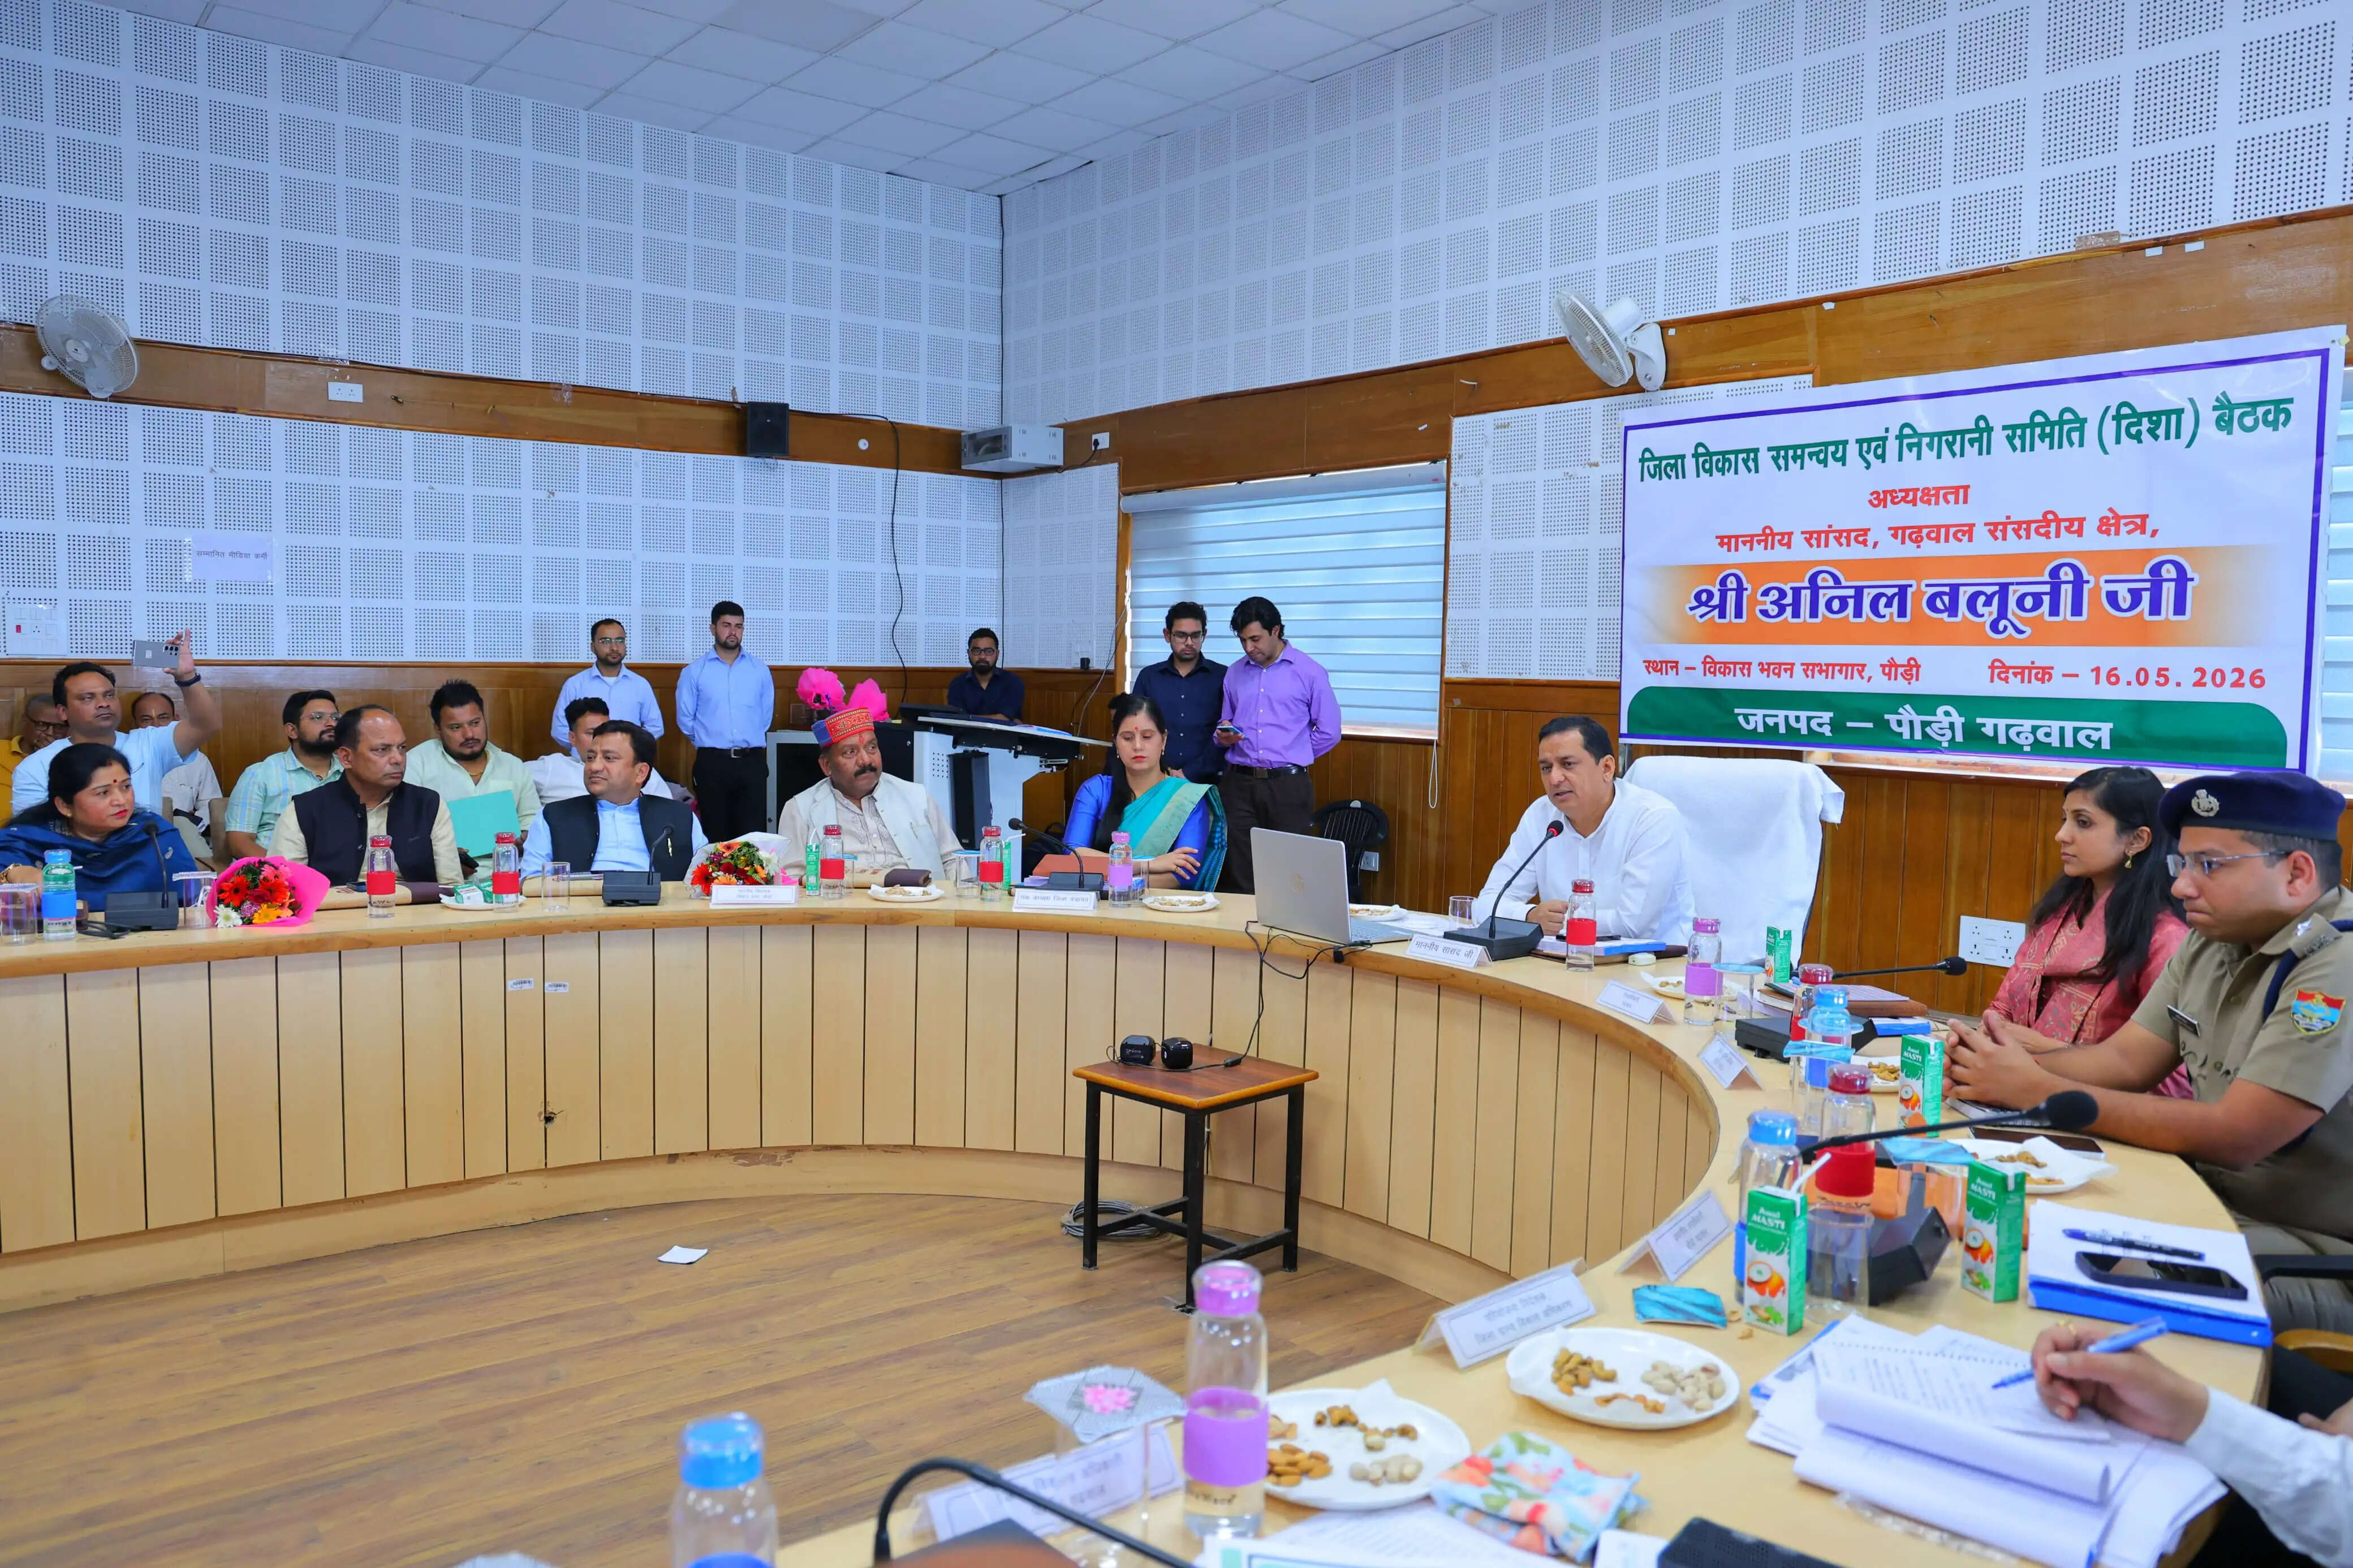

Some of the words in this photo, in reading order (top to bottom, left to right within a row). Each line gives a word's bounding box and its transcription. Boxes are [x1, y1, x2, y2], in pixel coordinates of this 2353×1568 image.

[1639, 447, 1686, 482] जिला
[1692, 442, 1760, 478] विकास
[1767, 439, 1848, 471] समन्वय
[1855, 427, 1889, 470] एवं
[1895, 414, 1993, 461] निगरानी
[2002, 407, 2087, 452] समिति
[2098, 398, 2200, 455] (दिशा)
[2213, 391, 2294, 435] बैठक
[1868, 485, 1970, 508] अध्यक्षता
[1716, 525, 1793, 552] माननीय
[1800, 524, 1879, 549] सांसद,
[1888, 523, 1976, 548] गढ़वाल
[1984, 510, 2086, 541] संसदीय
[2097, 507, 2160, 538] क्षेत्र,
[1687, 571, 1749, 621] श्री
[1758, 569, 1913, 620] अनिल
[1924, 561, 2090, 635] बलूनी
[2104, 558, 2195, 617] जी
[1643, 659, 1679, 676] स्थान
[1701, 655, 1752, 678] विकास
[1758, 660, 1795, 679] भवन
[1801, 662, 1872, 682] सभागार,
[1880, 656, 1921, 685] पौड़ी
[1988, 658, 2054, 684] दिनांक
[1734, 708, 1833, 736] जनपद
[1884, 704, 1965, 747] पौड़ी
[1976, 717, 2113, 751] गढ़वाल
[1415, 940, 1440, 952] माननीय
[1903, 1051, 1923, 1063] MASTI
[1970, 1182, 1996, 1200] MASTI
[1751, 1213, 1786, 1231] MASTI
